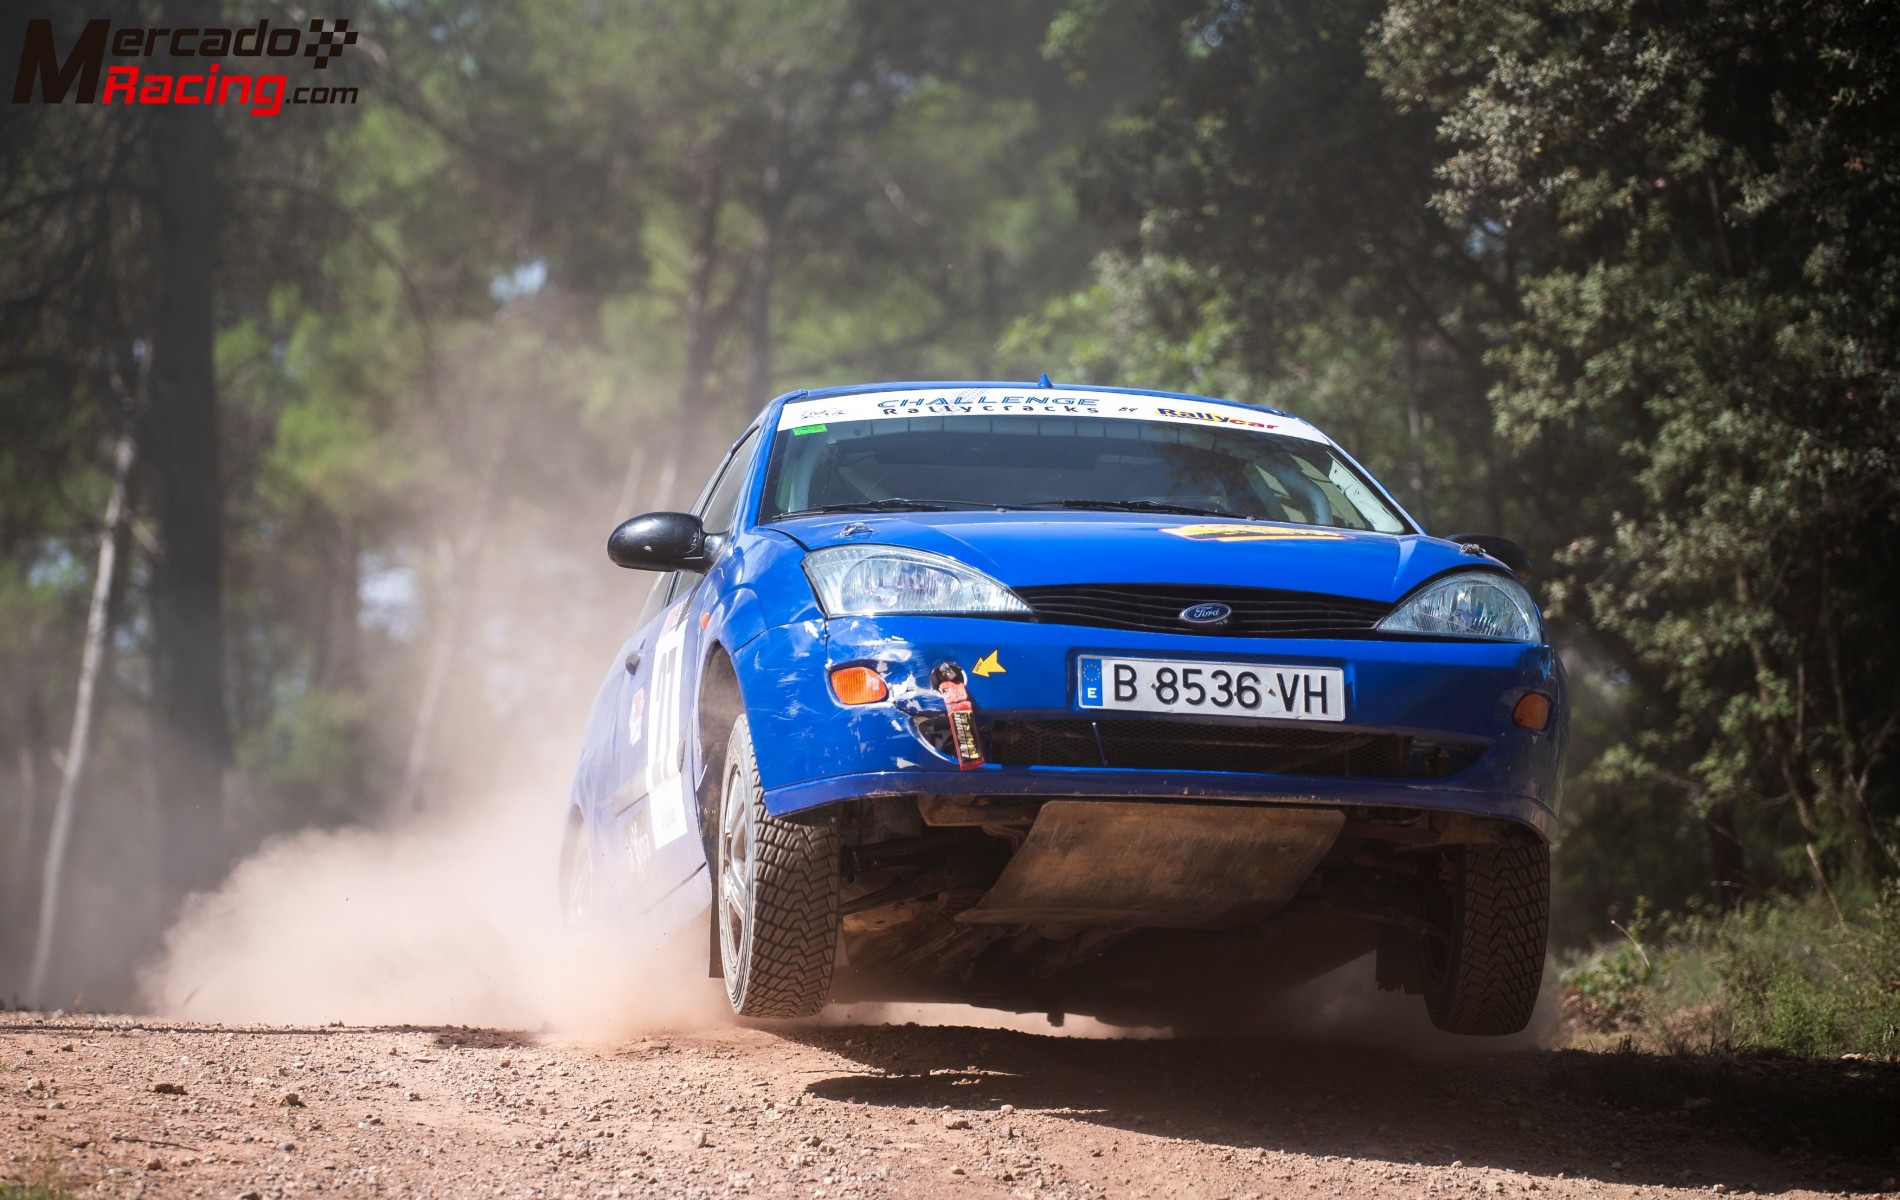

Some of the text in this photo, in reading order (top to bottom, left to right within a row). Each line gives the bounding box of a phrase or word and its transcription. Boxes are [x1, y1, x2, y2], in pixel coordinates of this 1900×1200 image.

[877, 396, 1100, 408] CHALLENGE
[882, 404, 1099, 415] Rallycracks
[1156, 407, 1279, 430] Rallycar
[1193, 606, 1220, 618] Ford
[1087, 664, 1328, 714] E B 8536 VH
